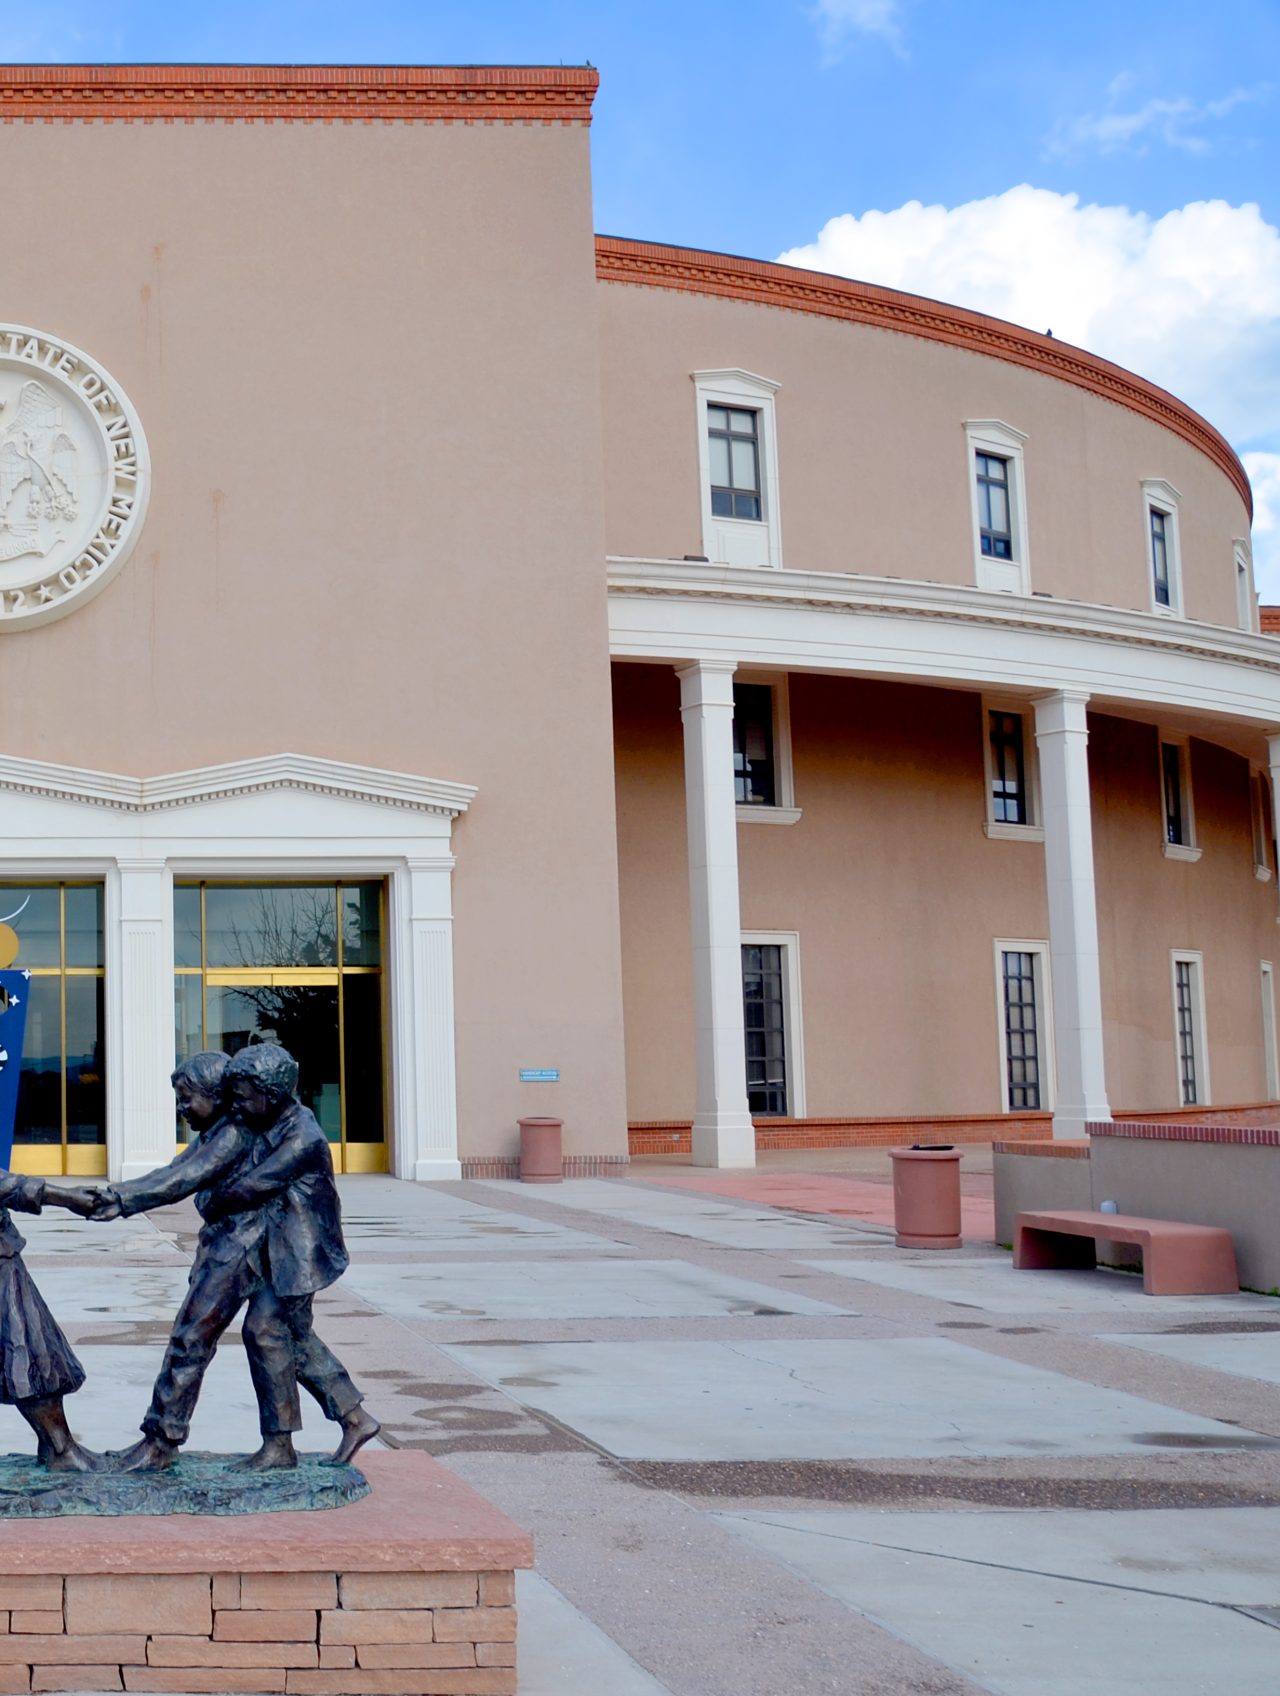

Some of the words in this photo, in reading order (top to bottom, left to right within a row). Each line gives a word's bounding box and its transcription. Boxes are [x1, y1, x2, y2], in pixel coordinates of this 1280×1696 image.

[79, 372, 118, 405] OF
[105, 416, 137, 481] NEW
[59, 496, 135, 590] MEXICO
